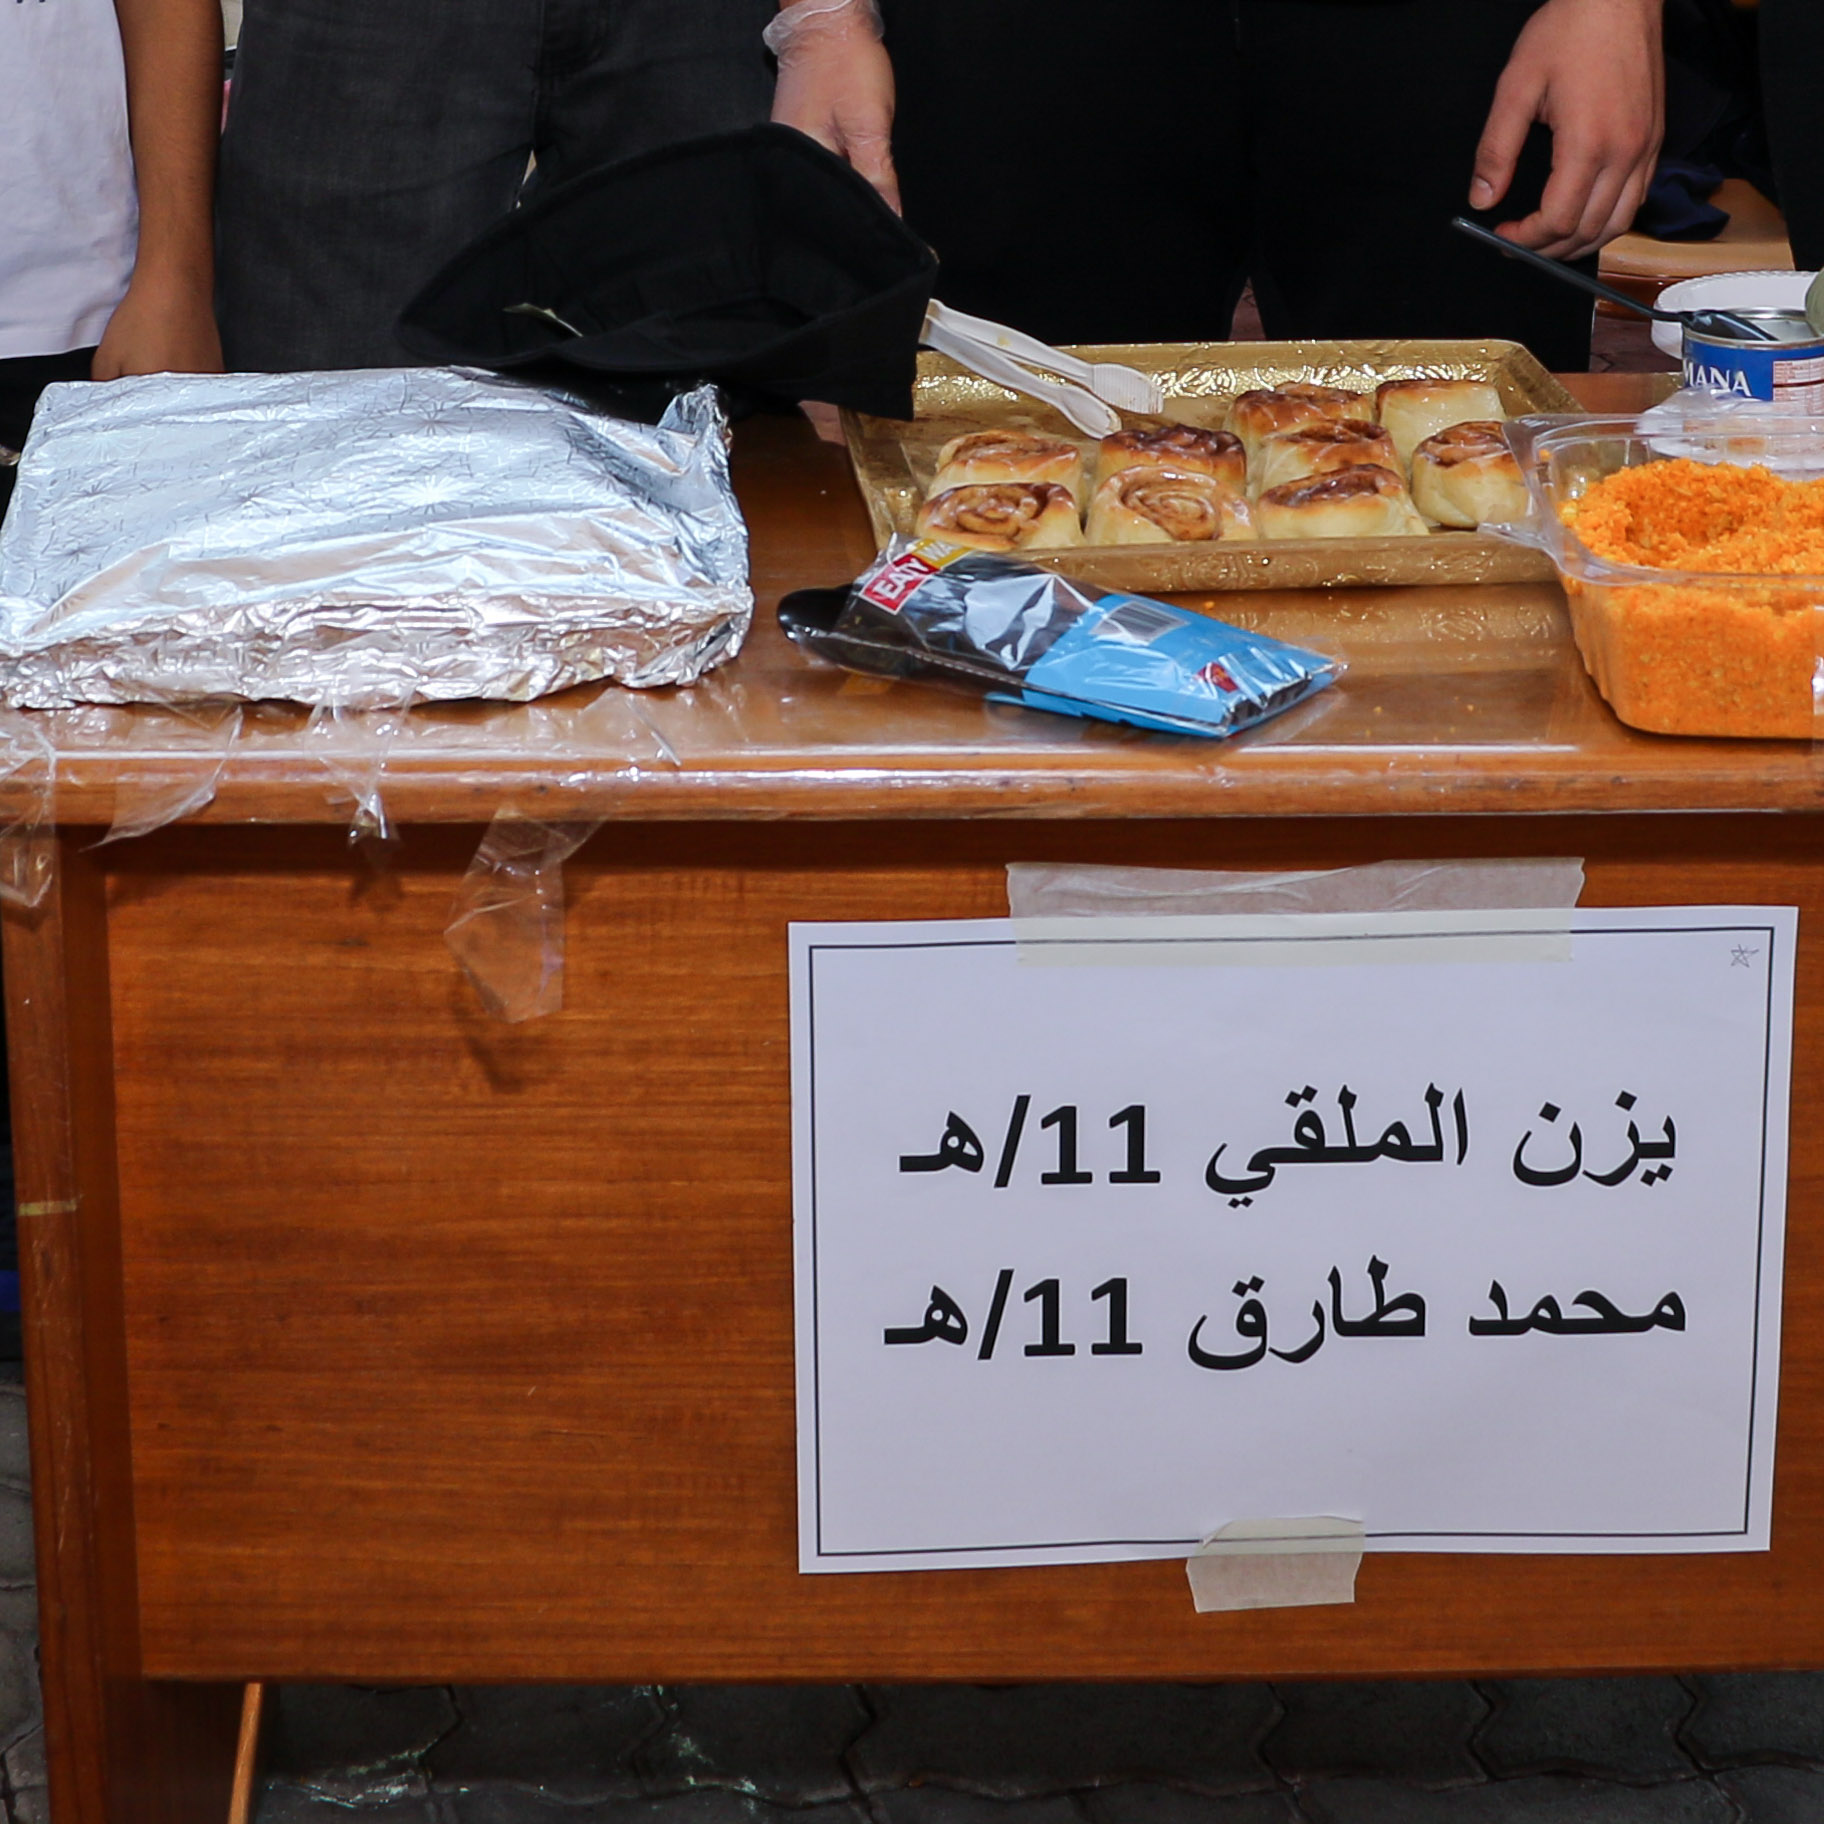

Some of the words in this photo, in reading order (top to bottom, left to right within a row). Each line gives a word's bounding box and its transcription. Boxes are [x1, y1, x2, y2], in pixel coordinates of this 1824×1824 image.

[917, 540, 958, 562] WA
[1203, 1082, 1468, 1209] الملقي
[1513, 1090, 1676, 1187] يزن
[1186, 1254, 1428, 1372] طارق
[1468, 1279, 1687, 1339] محمد
